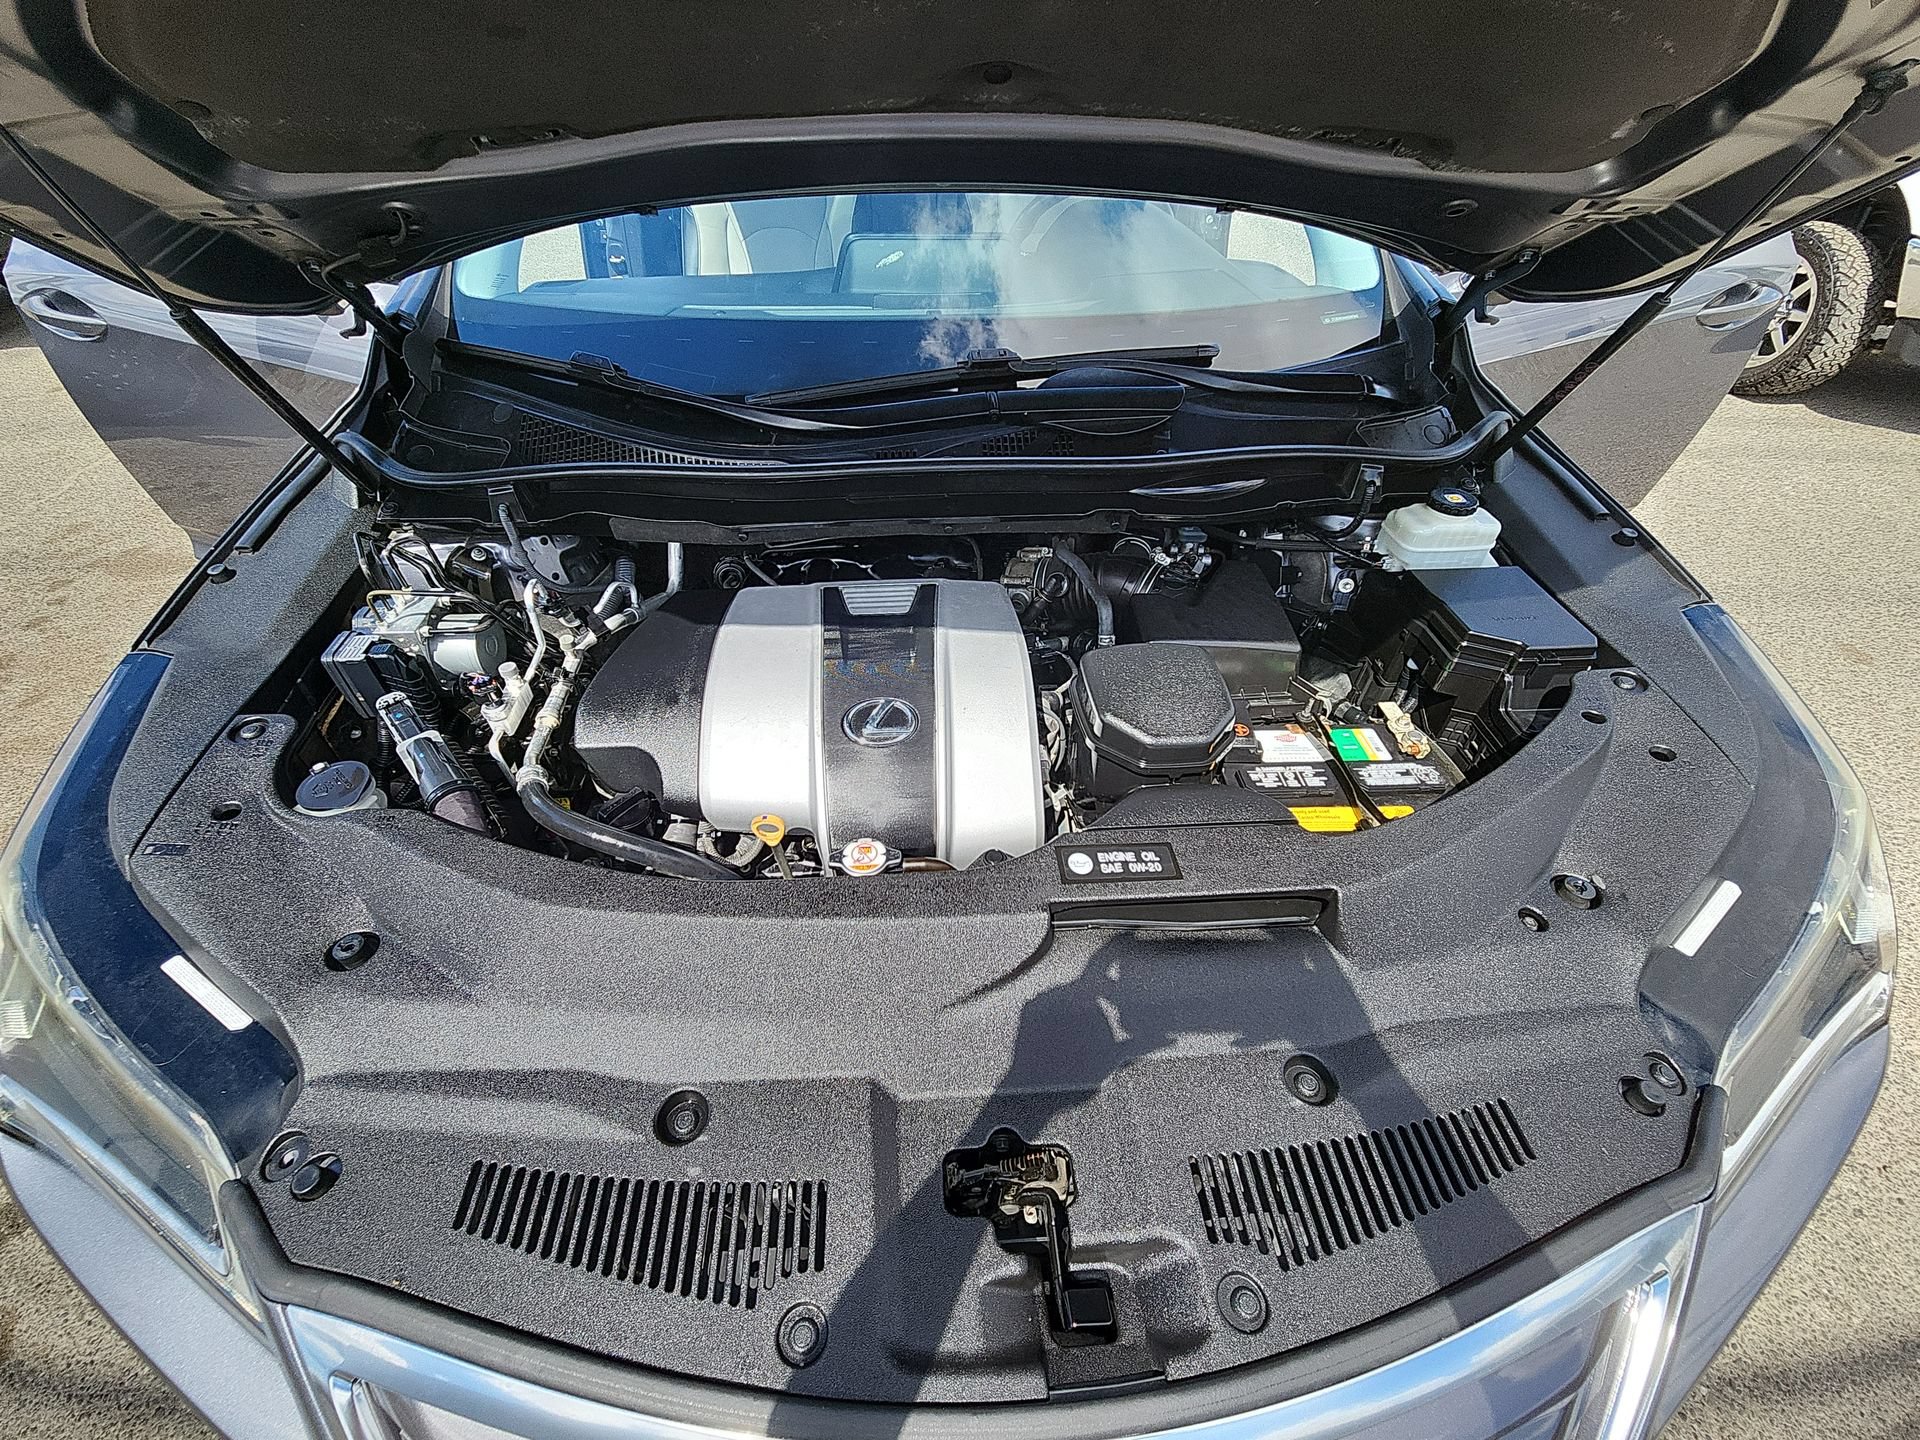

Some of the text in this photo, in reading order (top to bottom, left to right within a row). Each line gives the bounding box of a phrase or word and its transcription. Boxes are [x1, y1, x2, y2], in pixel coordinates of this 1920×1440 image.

[1097, 851, 1160, 862] ENGINE OIL
[1100, 863, 1124, 873] SAE
[1128, 862, 1162, 873] 0W-20
